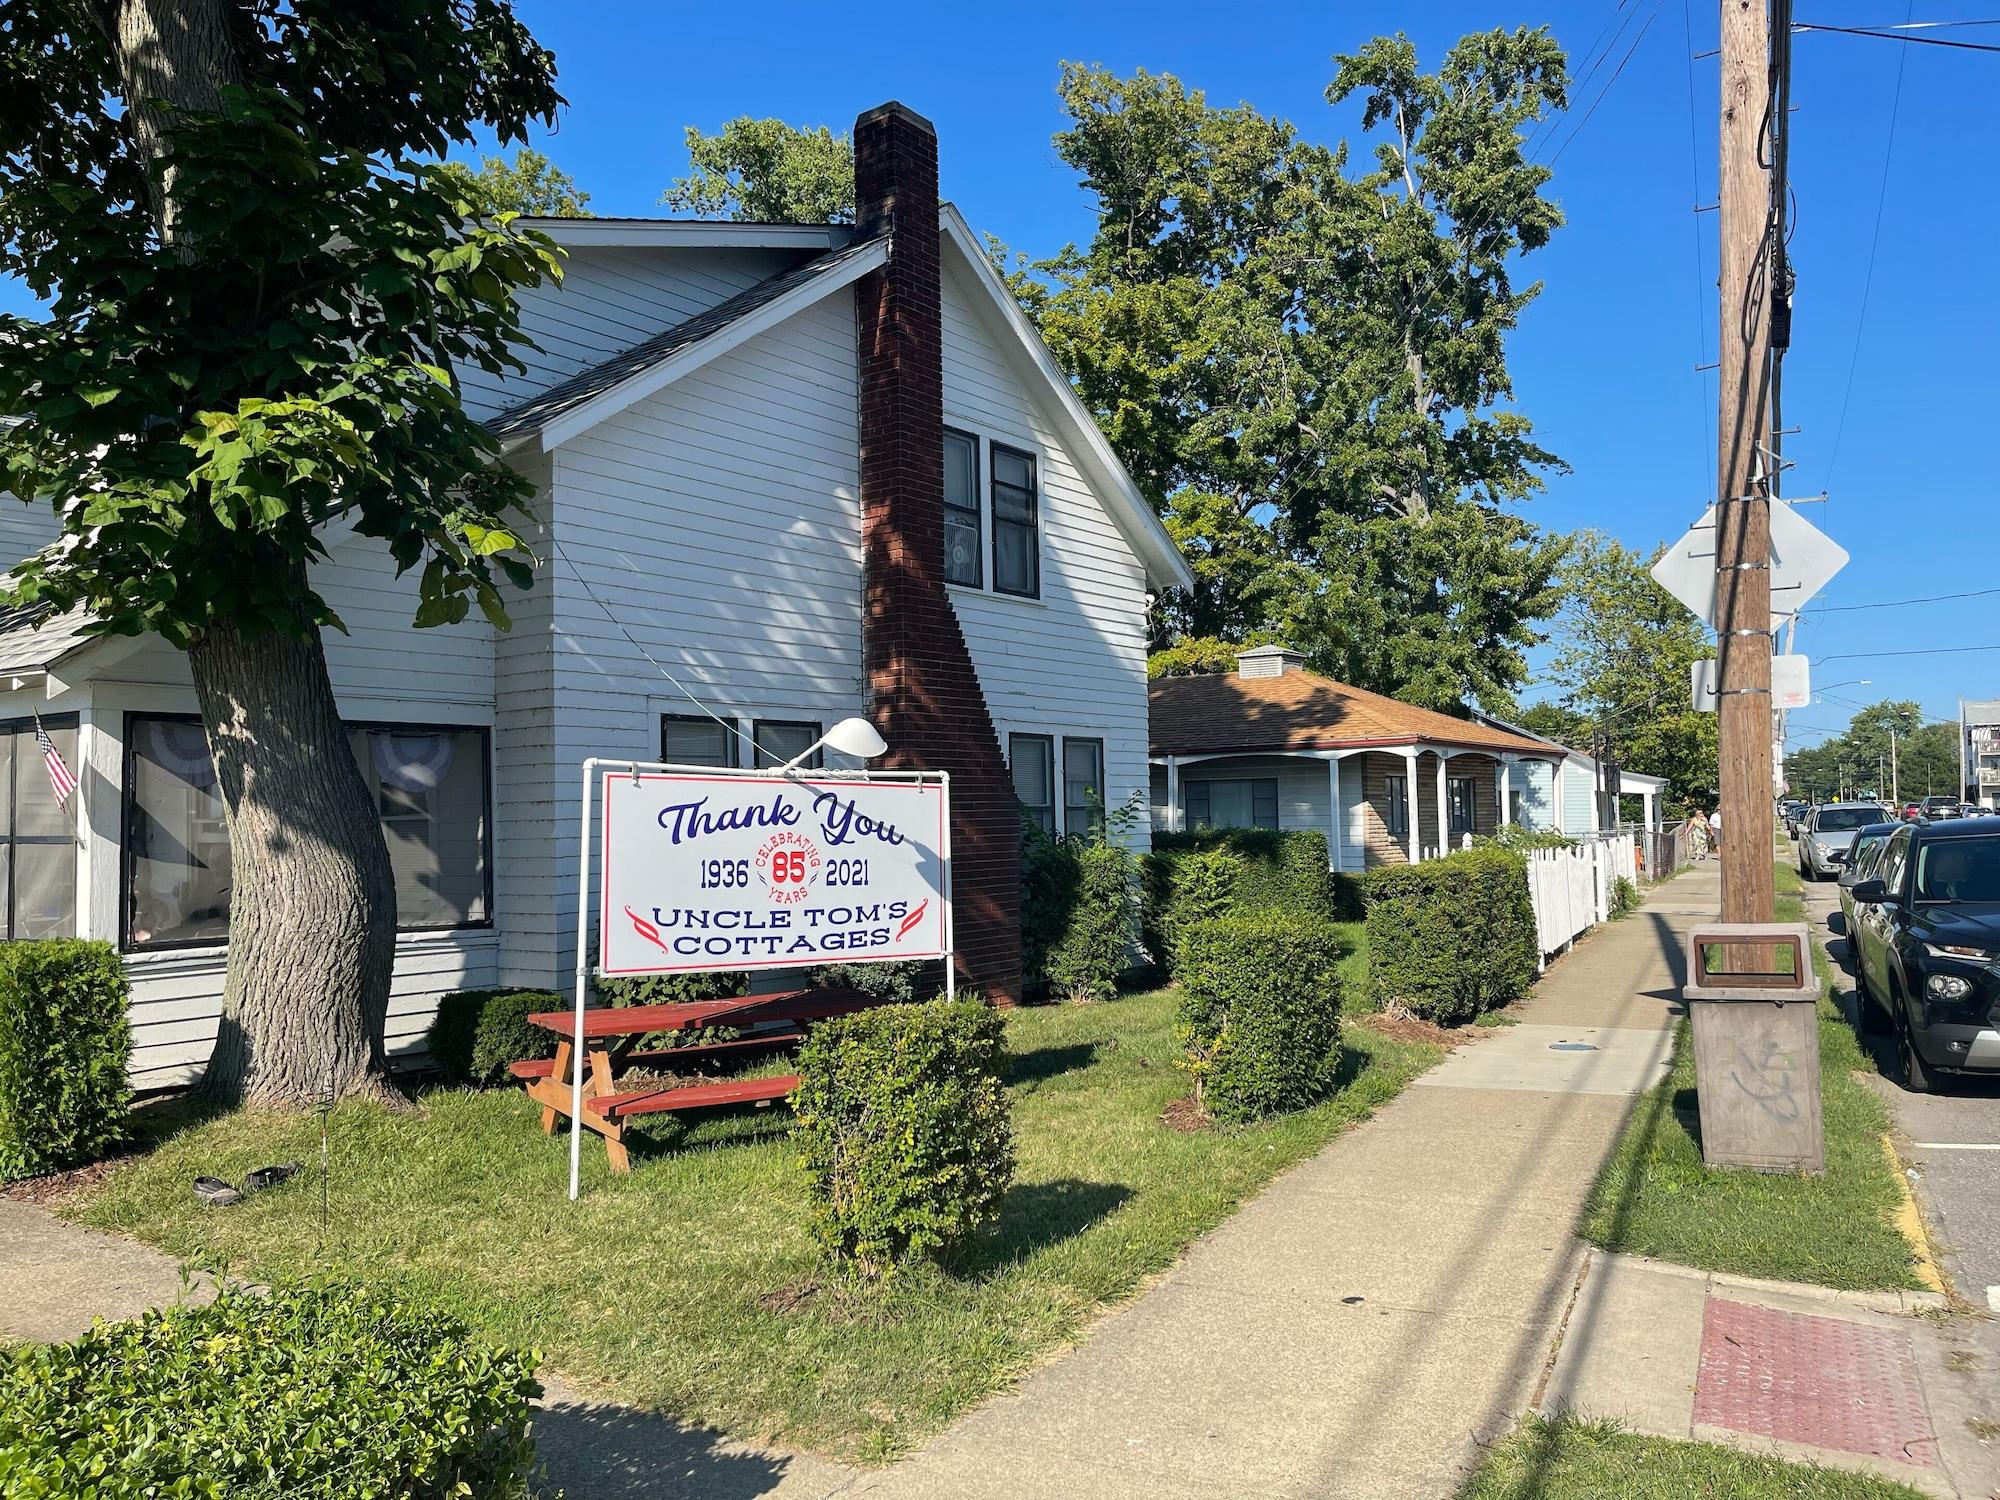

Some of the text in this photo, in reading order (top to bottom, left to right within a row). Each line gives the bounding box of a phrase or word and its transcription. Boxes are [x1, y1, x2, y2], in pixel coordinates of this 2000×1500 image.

[657, 792, 905, 846] Thank You
[755, 832, 821, 867] CELEBRATING
[701, 859, 749, 889] 1936
[772, 851, 806, 883] 85
[826, 858, 869, 887] 2021
[768, 886, 808, 904] YEARS
[652, 900, 908, 929] UNCLE TOM'S
[673, 927, 891, 955] COTTAGES
